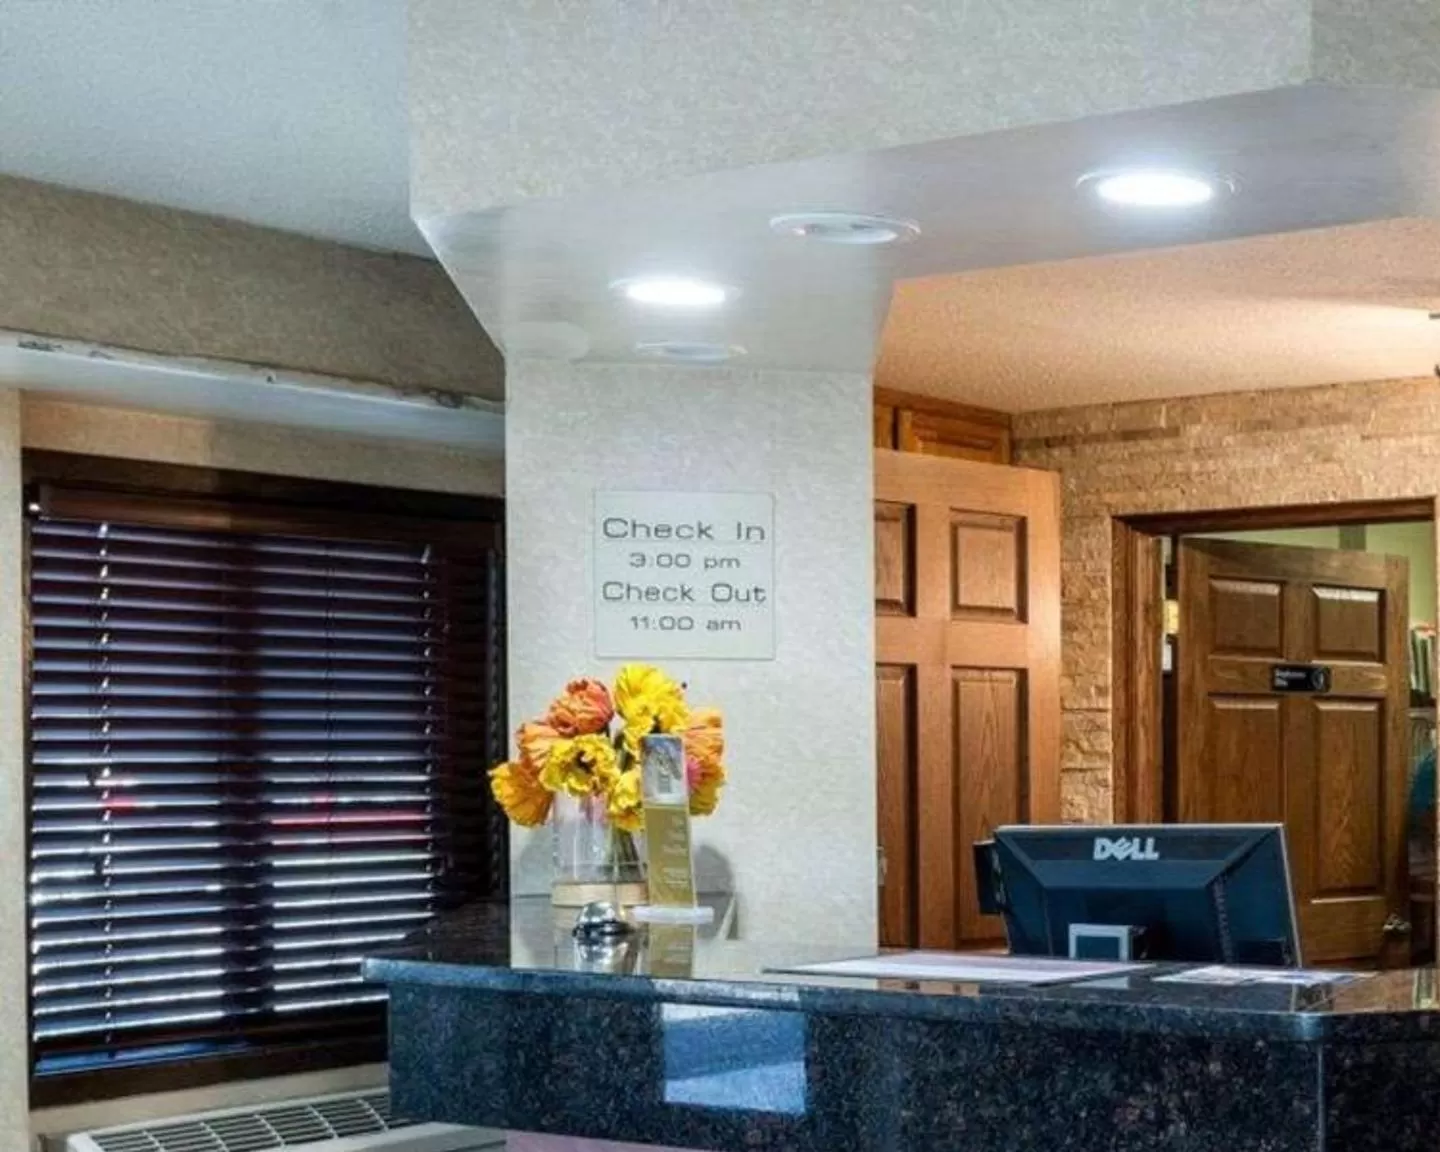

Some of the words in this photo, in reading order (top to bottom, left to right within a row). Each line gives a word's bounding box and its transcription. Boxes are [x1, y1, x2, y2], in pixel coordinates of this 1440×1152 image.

[602, 517, 714, 540] Check
[735, 521, 766, 541] In
[703, 556, 741, 570] pm
[602, 581, 695, 602] Check
[711, 582, 767, 603] Out
[629, 616, 694, 631] 11:00
[705, 619, 742, 631] am
[1093, 836, 1159, 860] DELL
